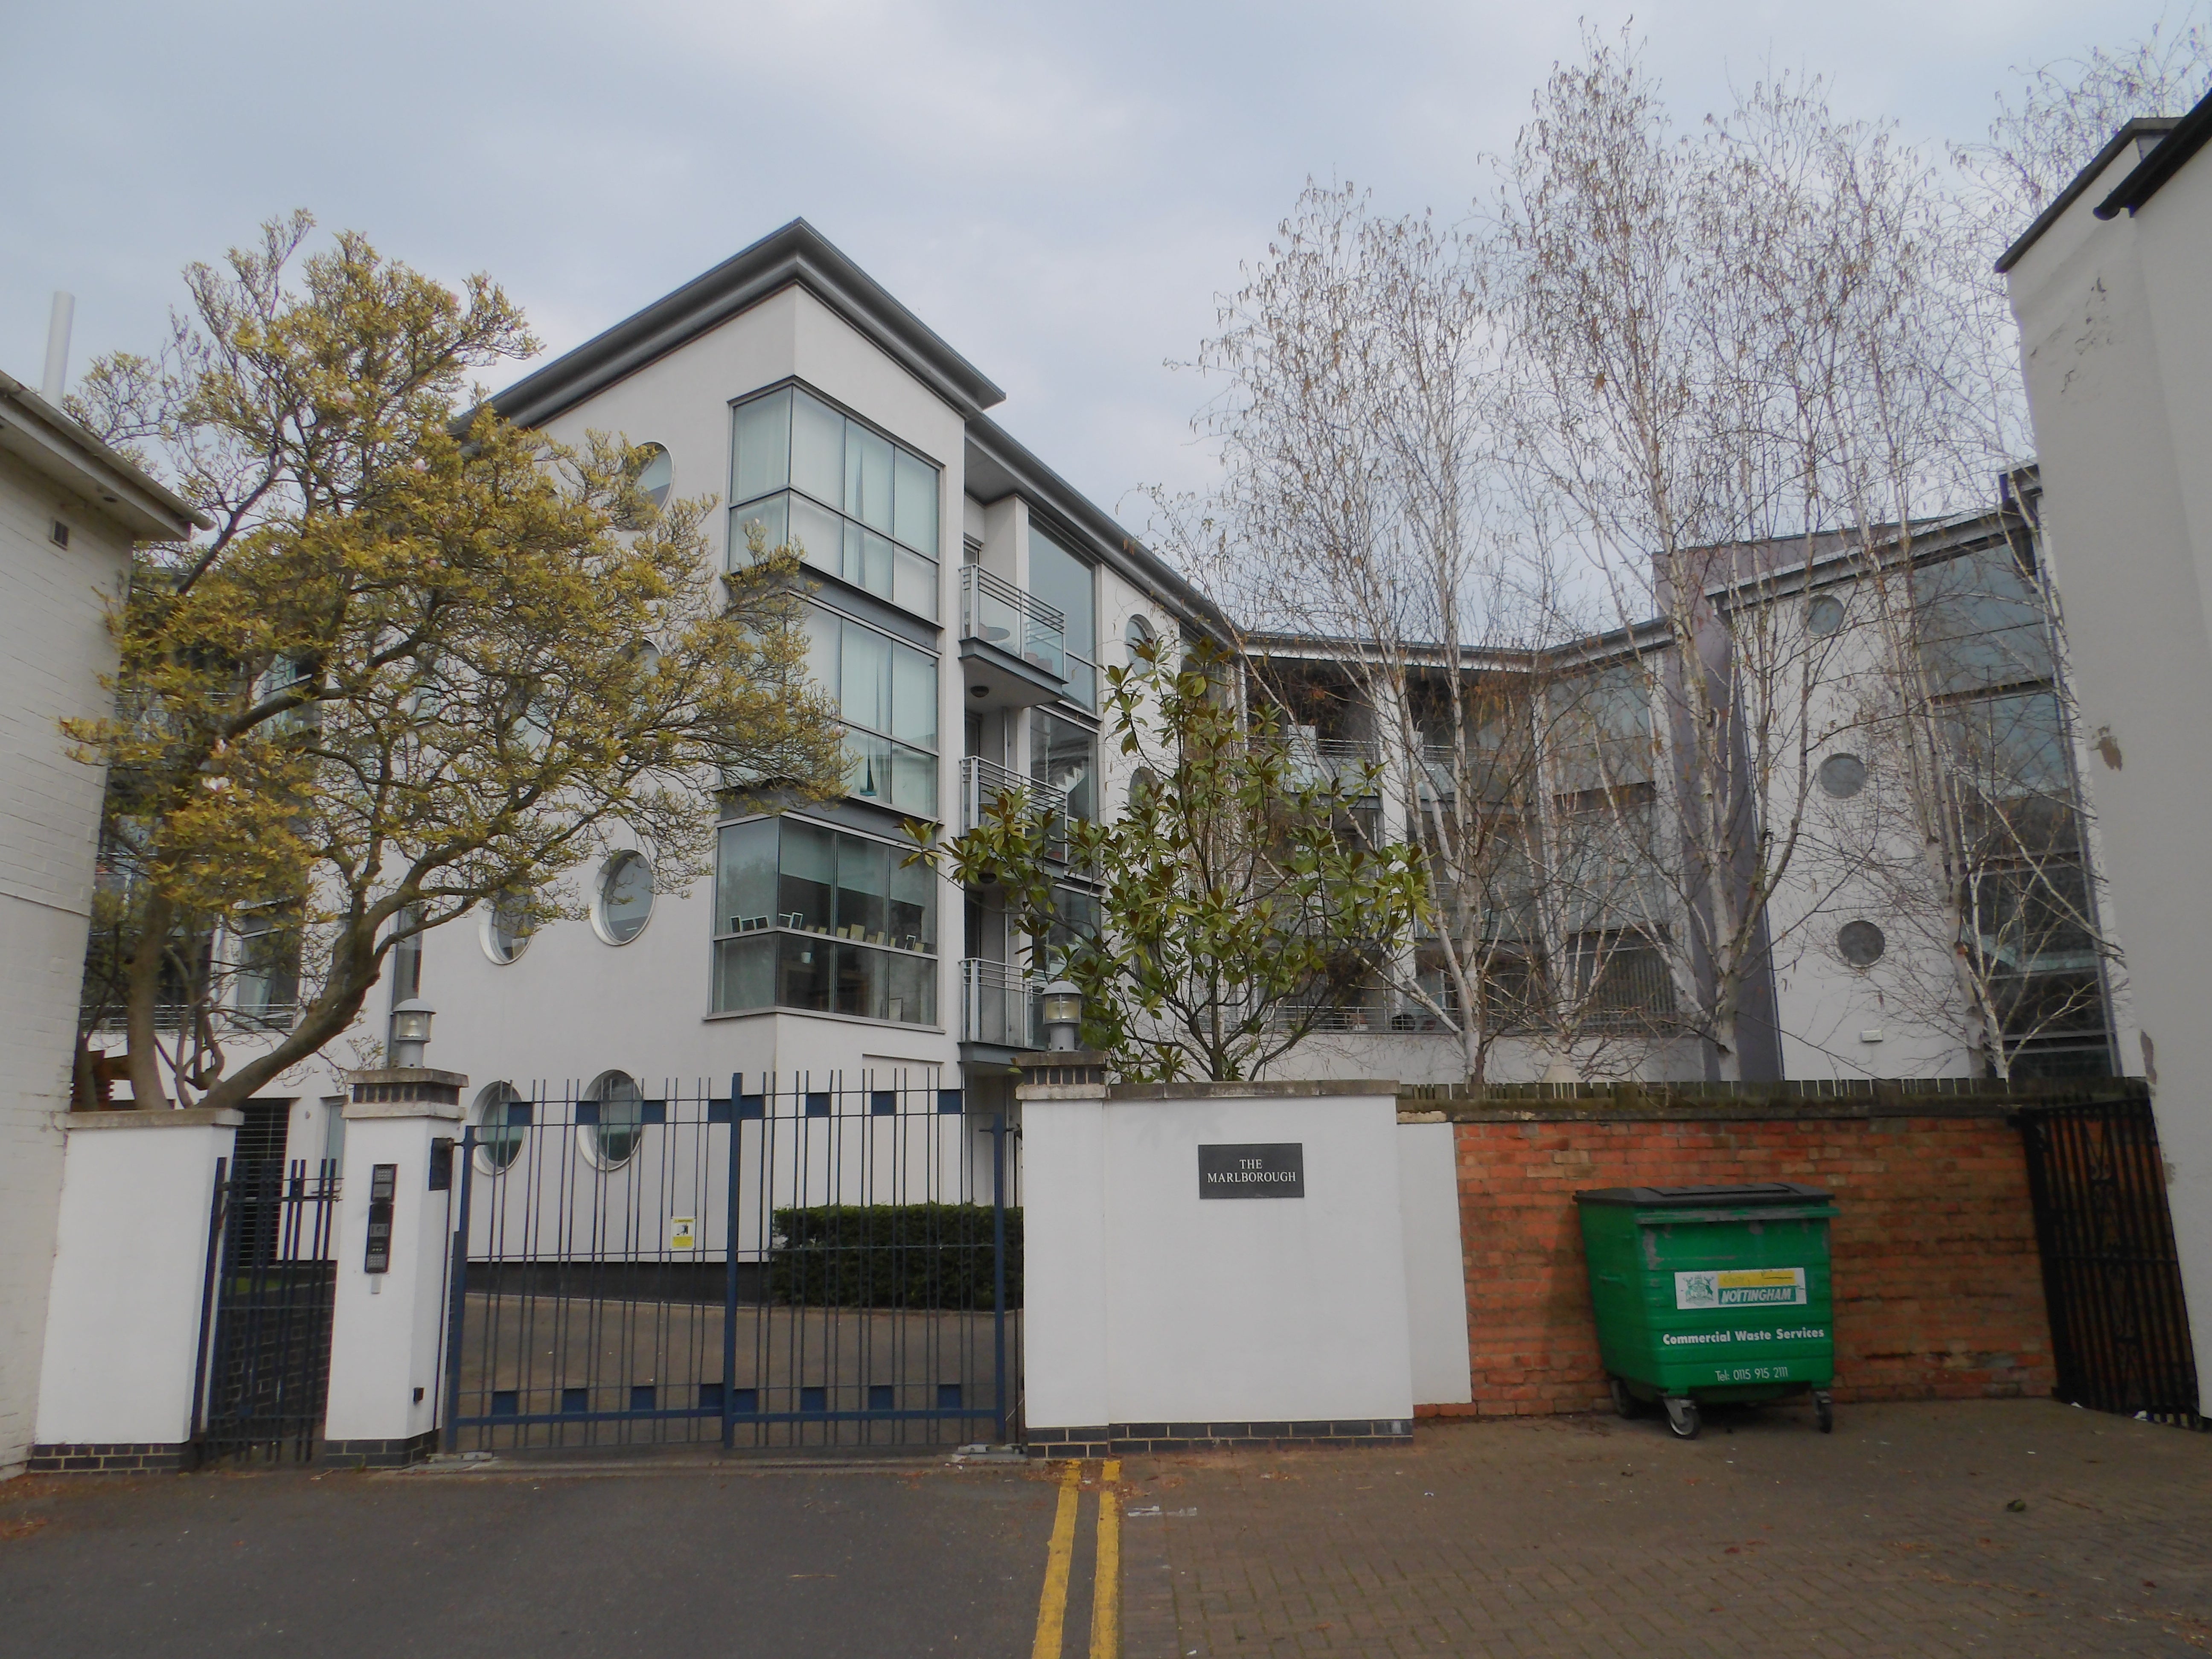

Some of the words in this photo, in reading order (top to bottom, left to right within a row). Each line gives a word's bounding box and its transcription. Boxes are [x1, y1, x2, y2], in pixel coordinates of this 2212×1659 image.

[1239, 1159, 1262, 1169] THE
[1207, 1172, 1296, 1183] MARLBOROUGH
[1721, 1288, 1792, 1304] NOTTINGHAM
[1663, 1330, 1731, 1345] Commercial
[1735, 1330, 1772, 1341] Waste
[1776, 1327, 1824, 1340] Services
[1715, 1369, 1730, 1382] Tel:
[1733, 1369, 1751, 1380] 0115
[1754, 1368, 1770, 1379] 915
[1773, 1367, 1788, 1378] 2111
